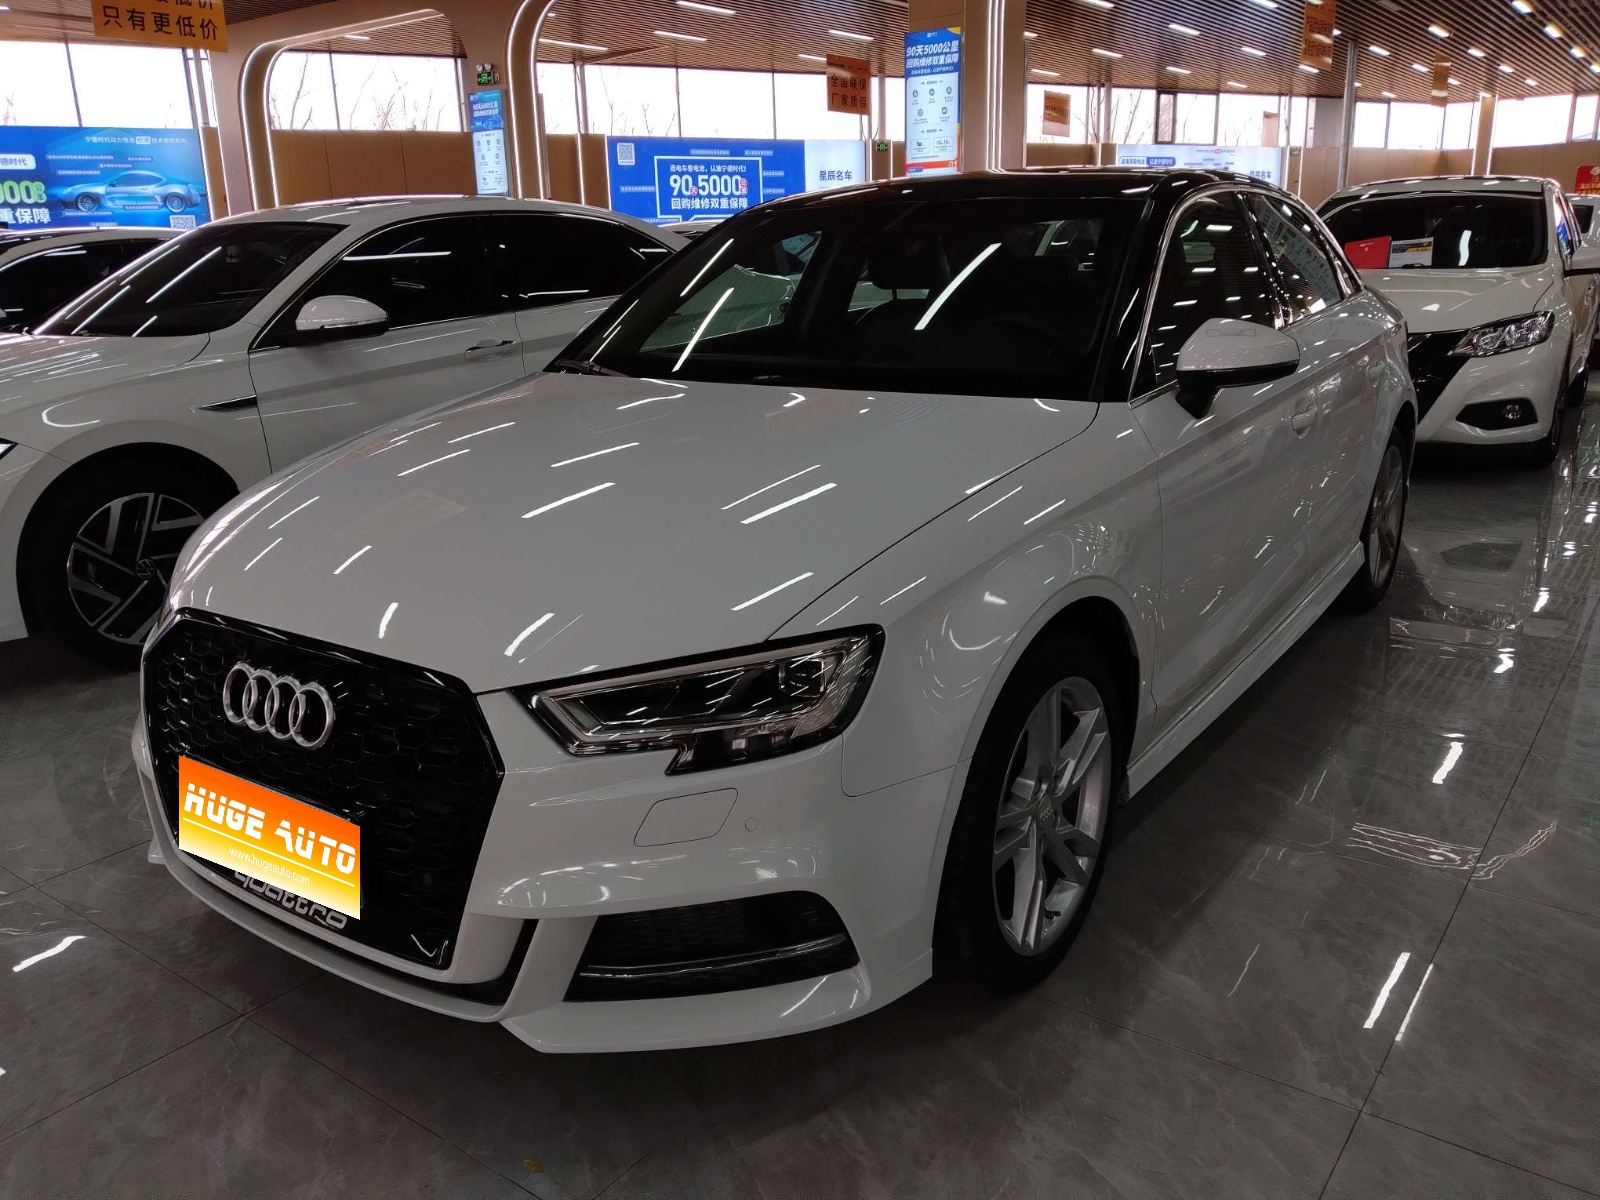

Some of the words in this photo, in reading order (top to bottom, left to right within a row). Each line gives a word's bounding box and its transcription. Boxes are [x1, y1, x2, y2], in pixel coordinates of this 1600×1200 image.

[102, 5, 218, 41] 只有更低价
[831, 93, 867, 109] 厂家质保
[819, 170, 853, 181] 星辰名车
[671, 197, 748, 210] 回购维修双重保障
